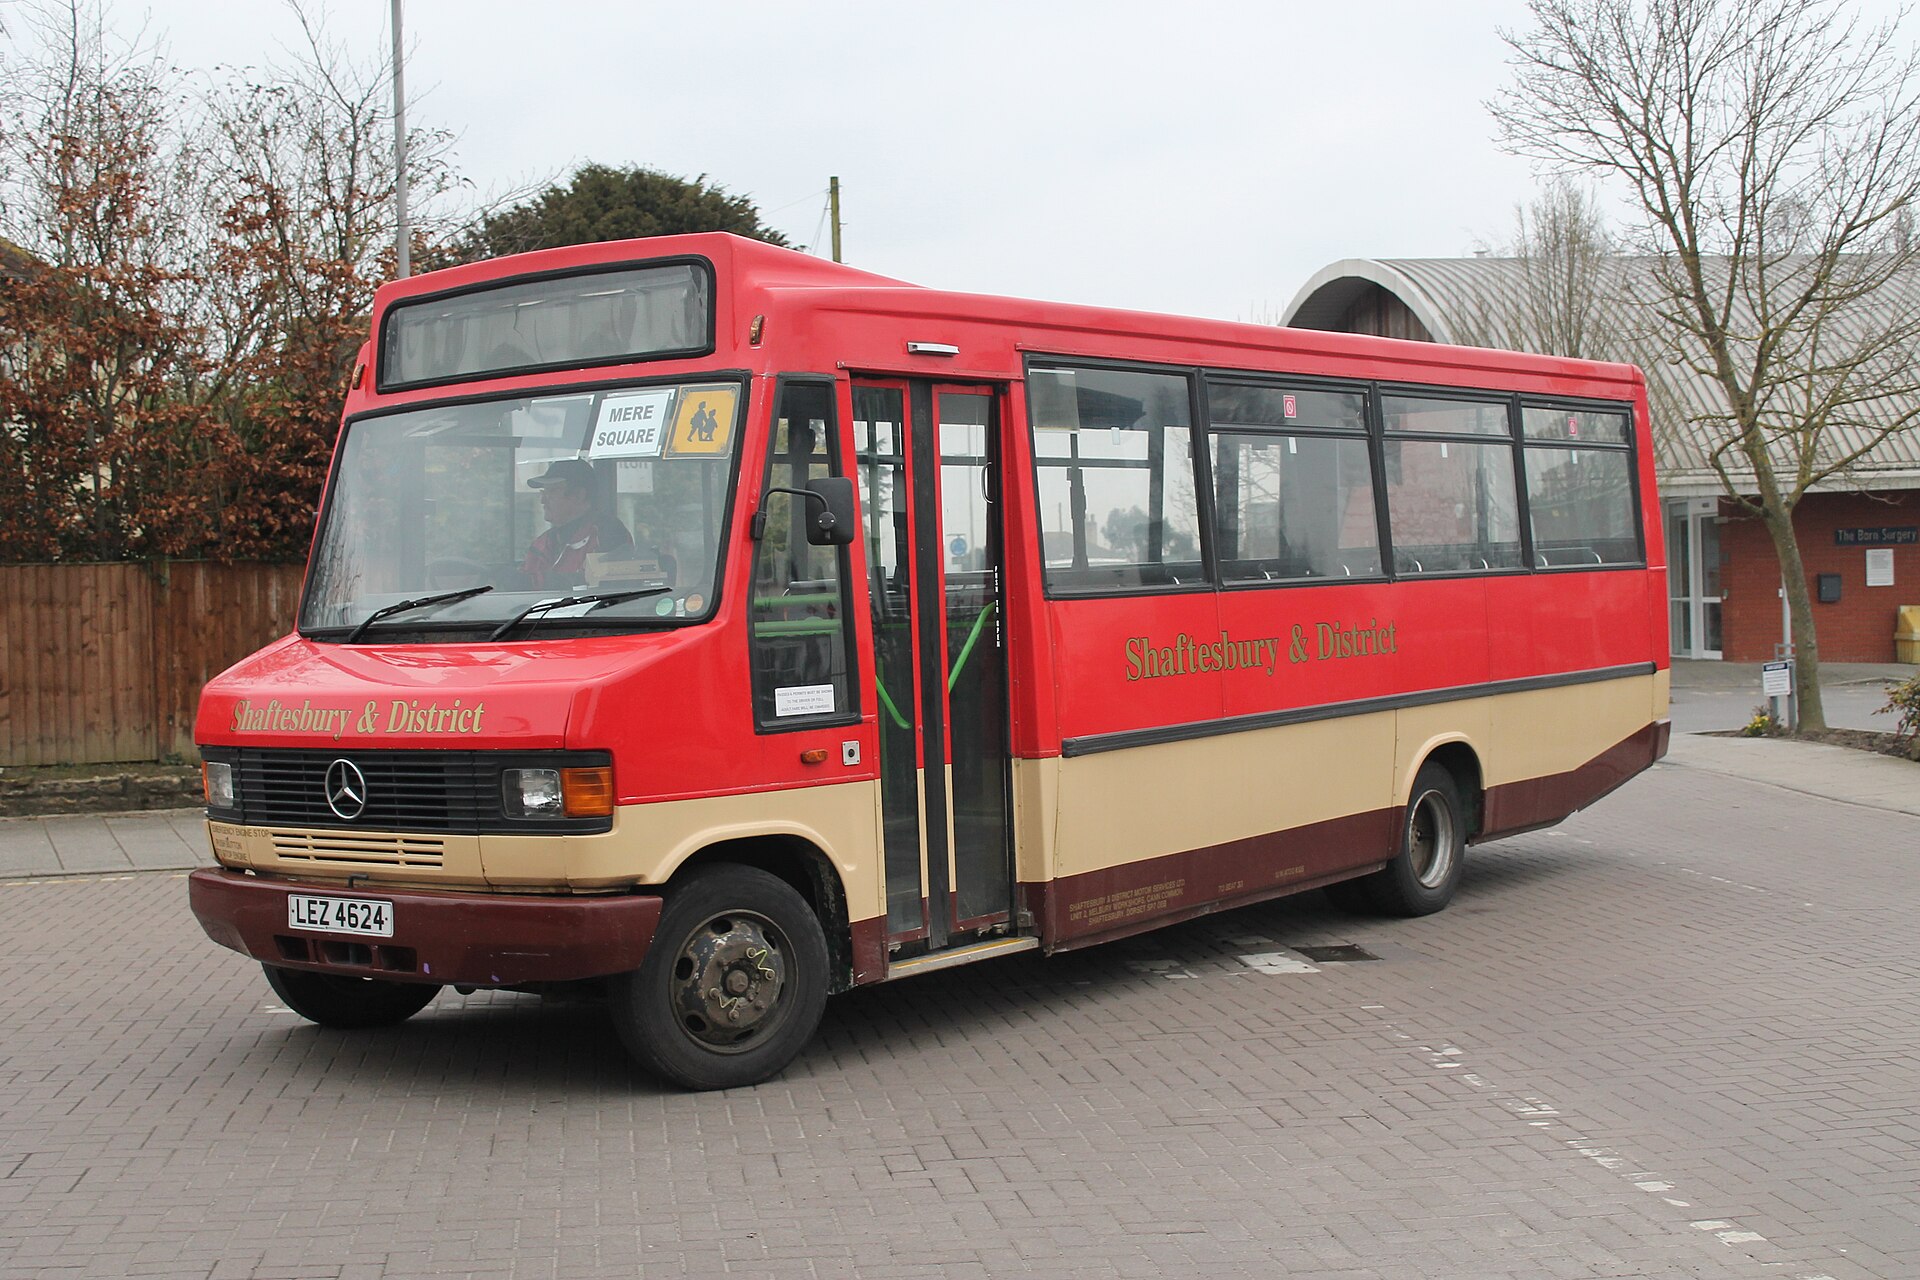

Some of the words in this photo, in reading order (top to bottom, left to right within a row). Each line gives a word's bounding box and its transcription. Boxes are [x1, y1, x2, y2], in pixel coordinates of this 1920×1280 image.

[608, 405, 655, 423] MERE
[596, 428, 656, 446] SQUARE
[1838, 529, 1854, 541] The
[1857, 529, 1879, 541] Barn
[1882, 528, 1917, 543] Surgery
[1124, 631, 1279, 682] Shaftesbury
[1289, 624, 1310, 664] &
[1315, 618, 1398, 661] District
[230, 699, 352, 741] Shaftesbury
[357, 700, 380, 734] &
[385, 699, 485, 734] District
[253, 829, 270, 838] STOP
[295, 898, 330, 926] LEZ
[335, 901, 385, 931] 4624
